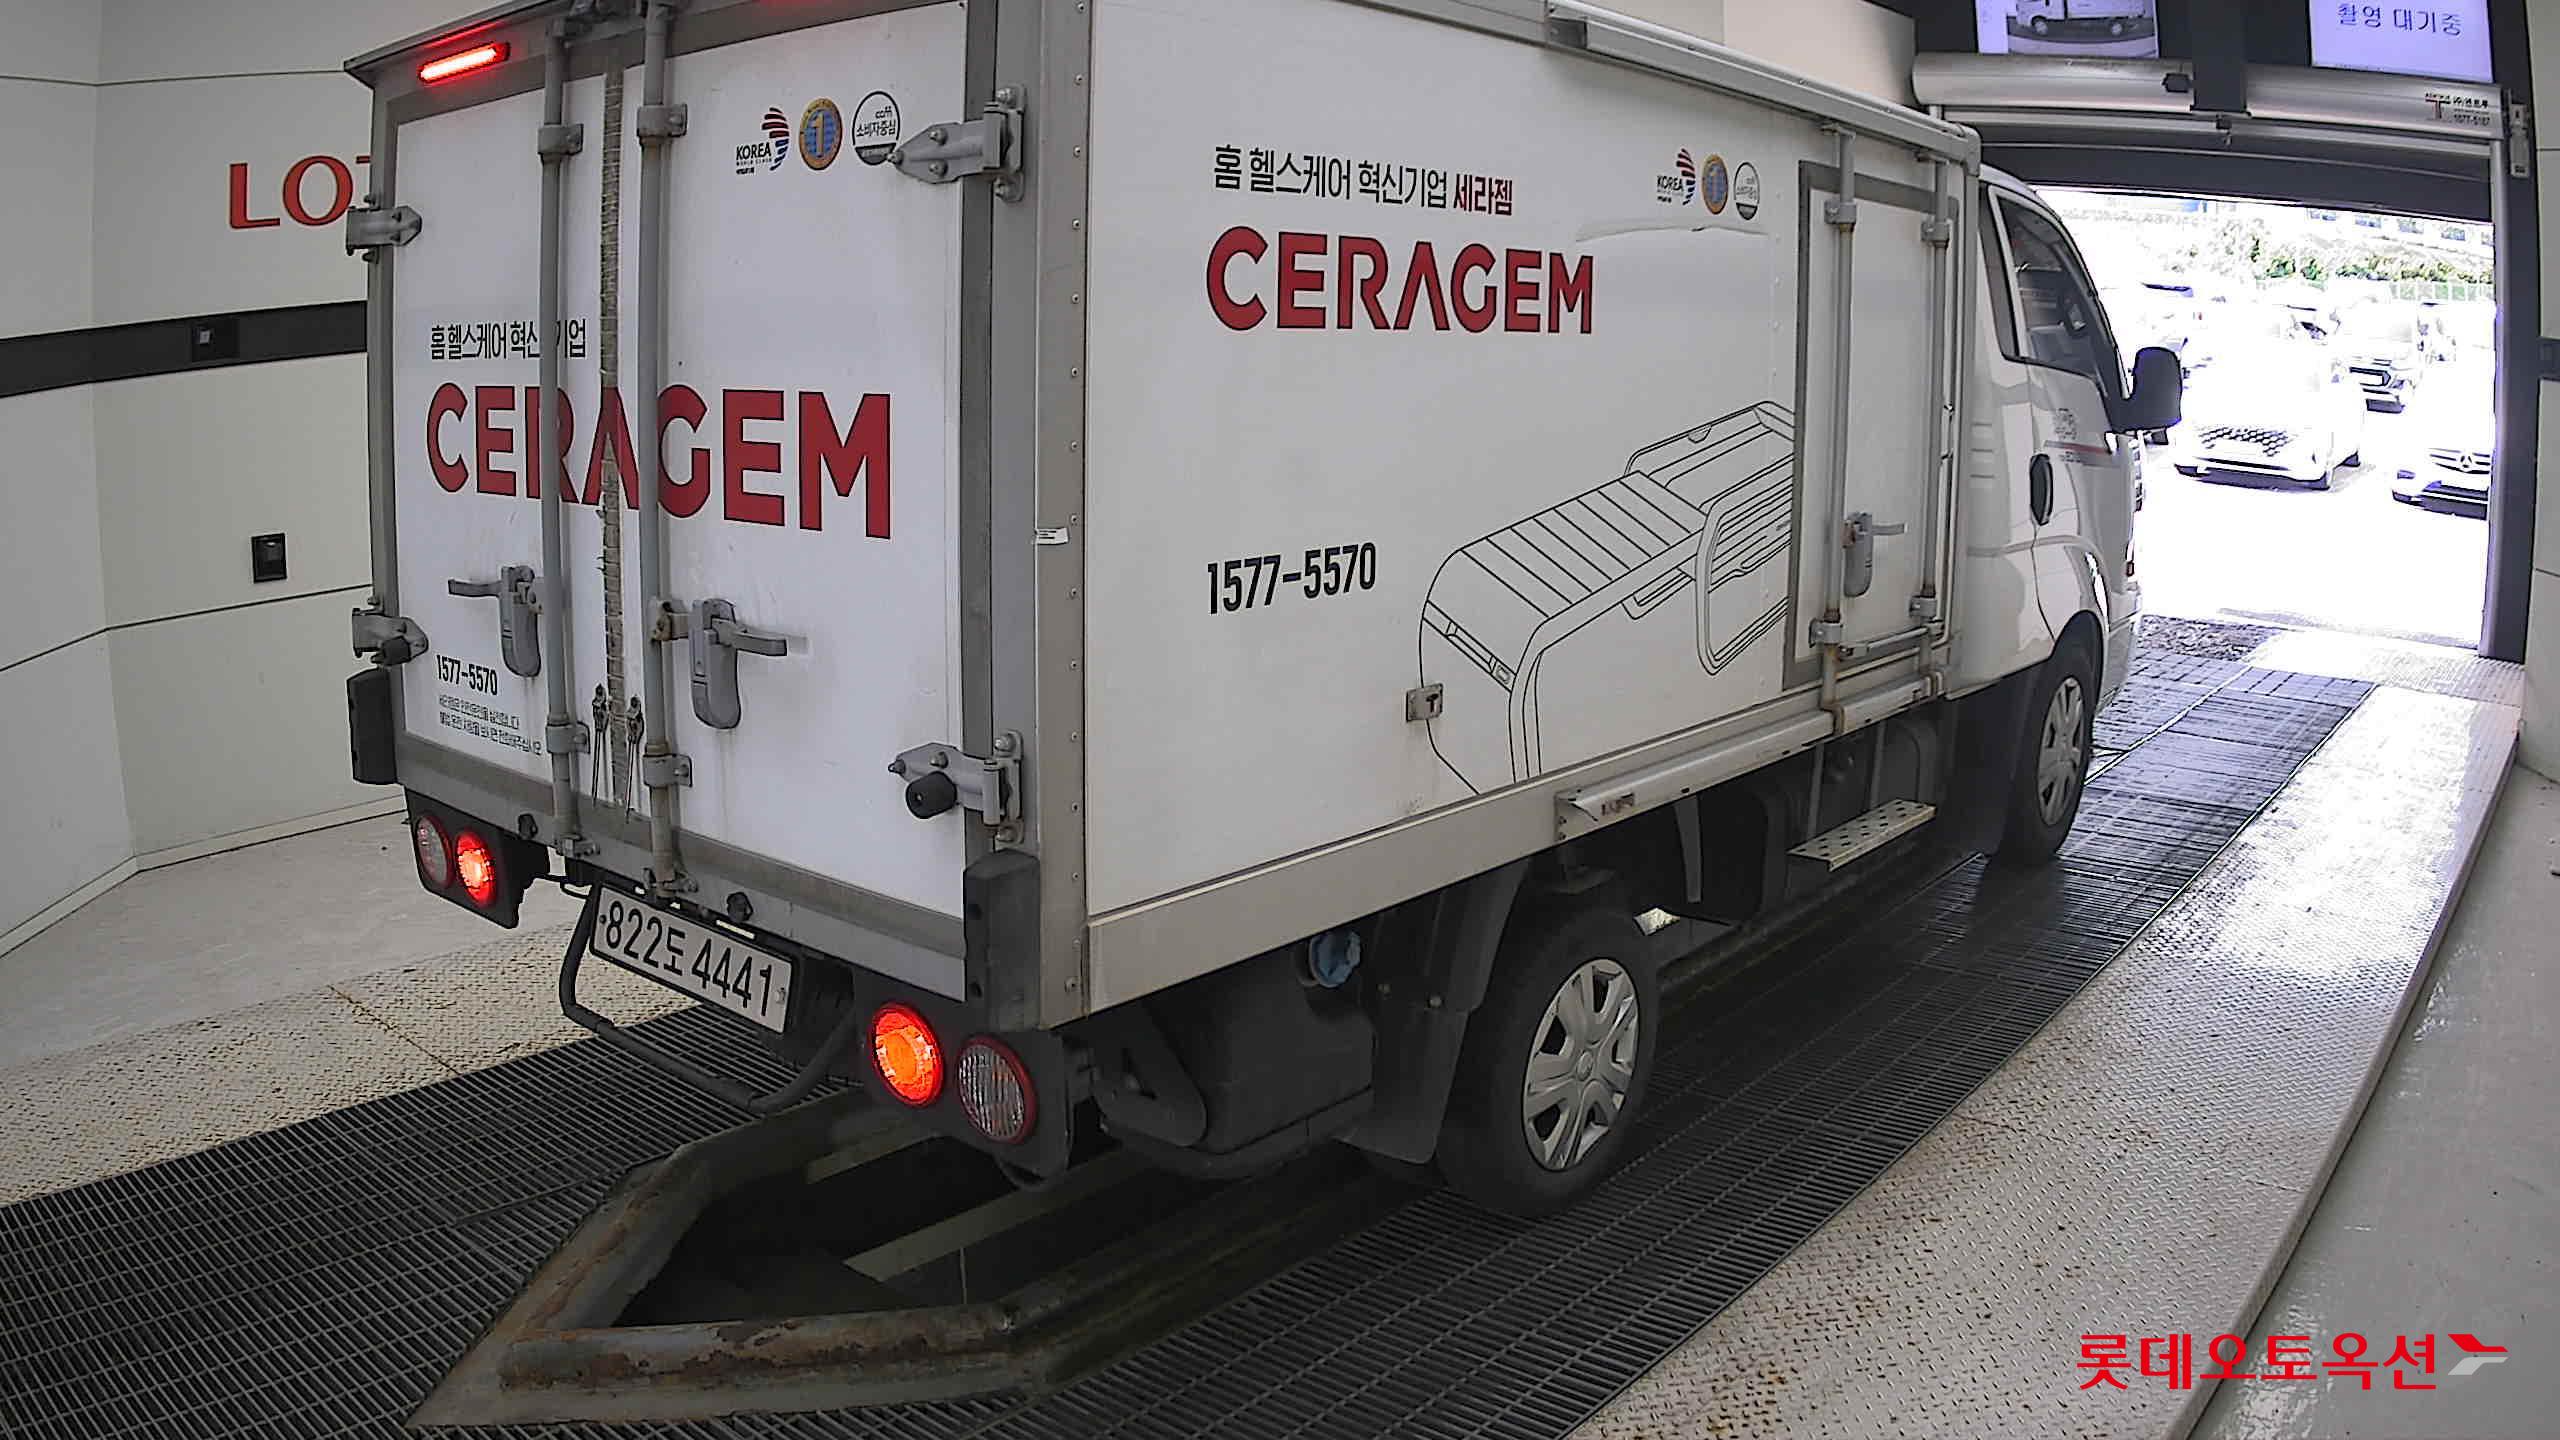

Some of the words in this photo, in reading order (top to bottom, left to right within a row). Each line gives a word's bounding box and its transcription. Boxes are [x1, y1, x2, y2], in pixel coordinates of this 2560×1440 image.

[2393, 9, 2461, 36] 대기중
[736, 142, 772, 160] KOREA
[1214, 144, 1242, 190] 홈
[1249, 147, 1351, 200] 헬스케어
[1358, 160, 1448, 209] 혁신기업
[1453, 173, 1513, 216] 세라젬
[1206, 226, 1594, 334] CERAGEM
[426, 382, 891, 539] CERAGEM
[1207, 542, 1376, 615] 1577-5570
[437, 655, 498, 696] 1577-5570
